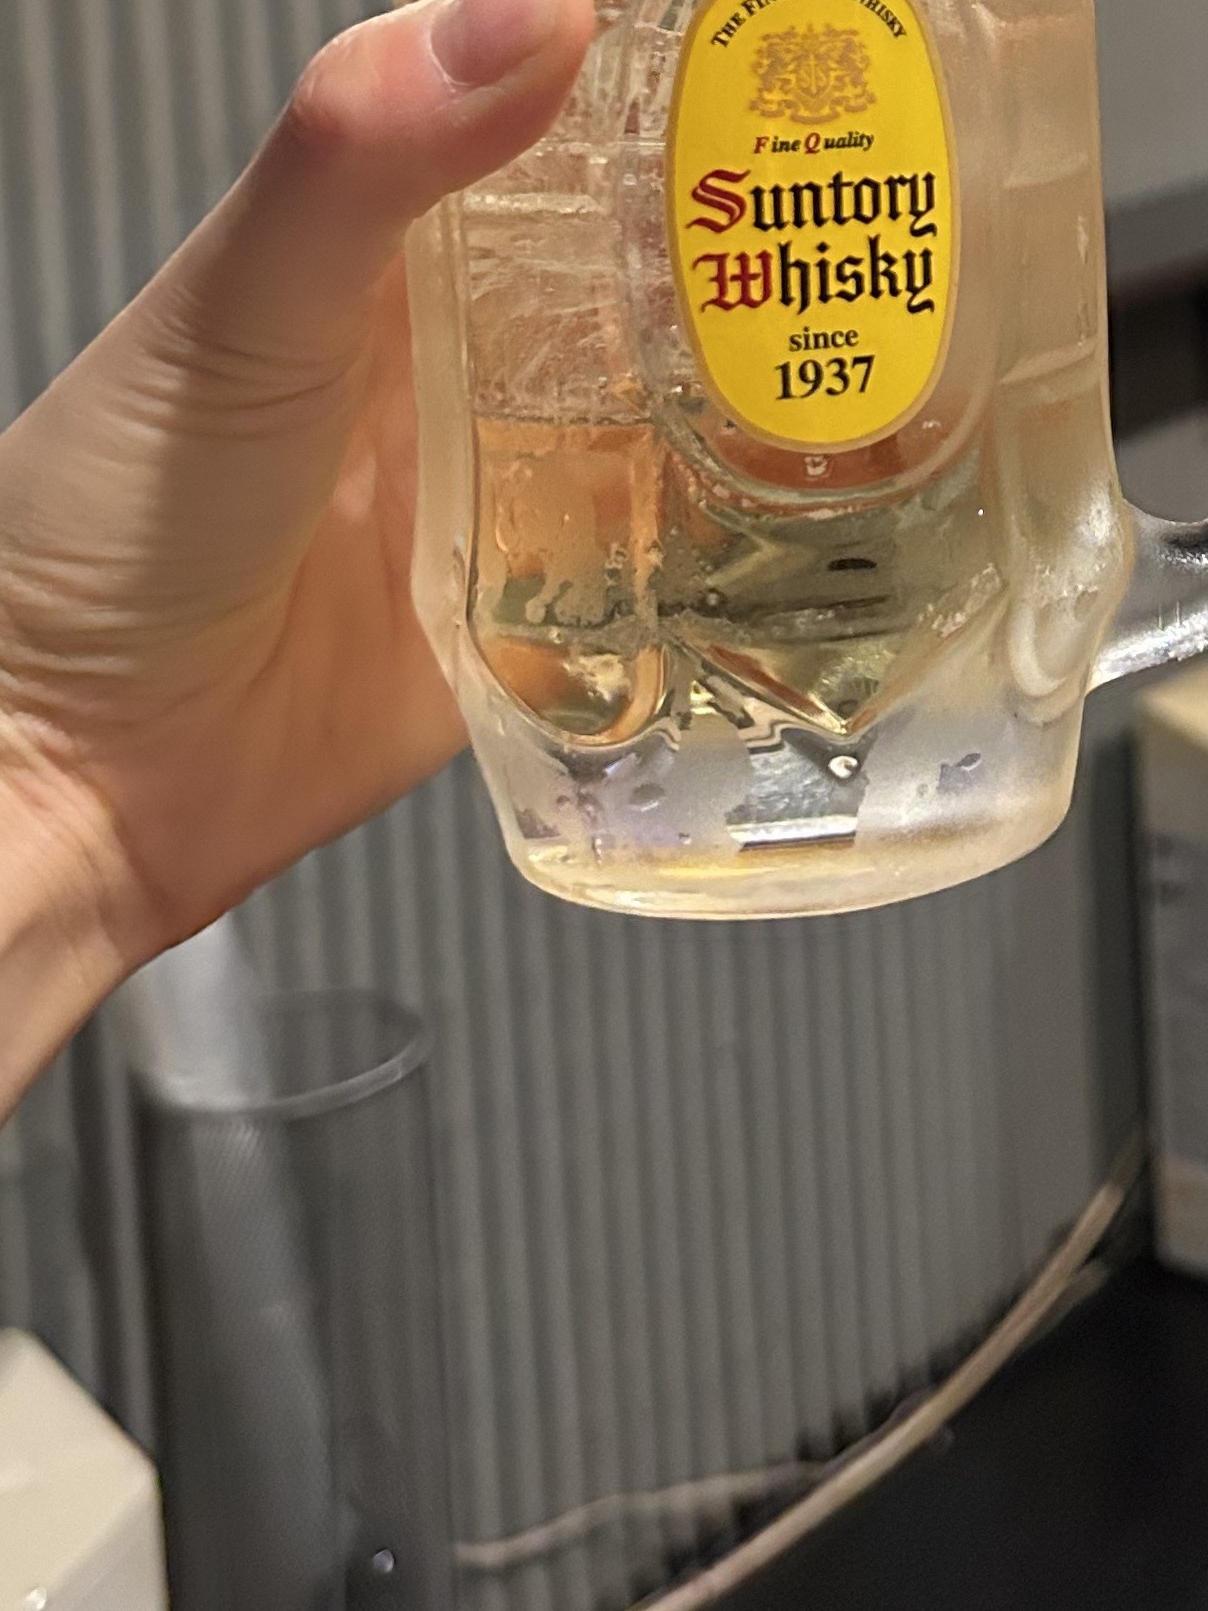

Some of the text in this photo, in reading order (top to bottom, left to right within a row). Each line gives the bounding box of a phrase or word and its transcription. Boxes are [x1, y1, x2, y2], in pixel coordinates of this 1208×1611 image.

[711, 11, 747, 48] THE
[685, 168, 938, 237] Suntory
[691, 234, 935, 315] Whisky
[788, 326, 859, 353] since
[774, 355, 876, 401] 1937
